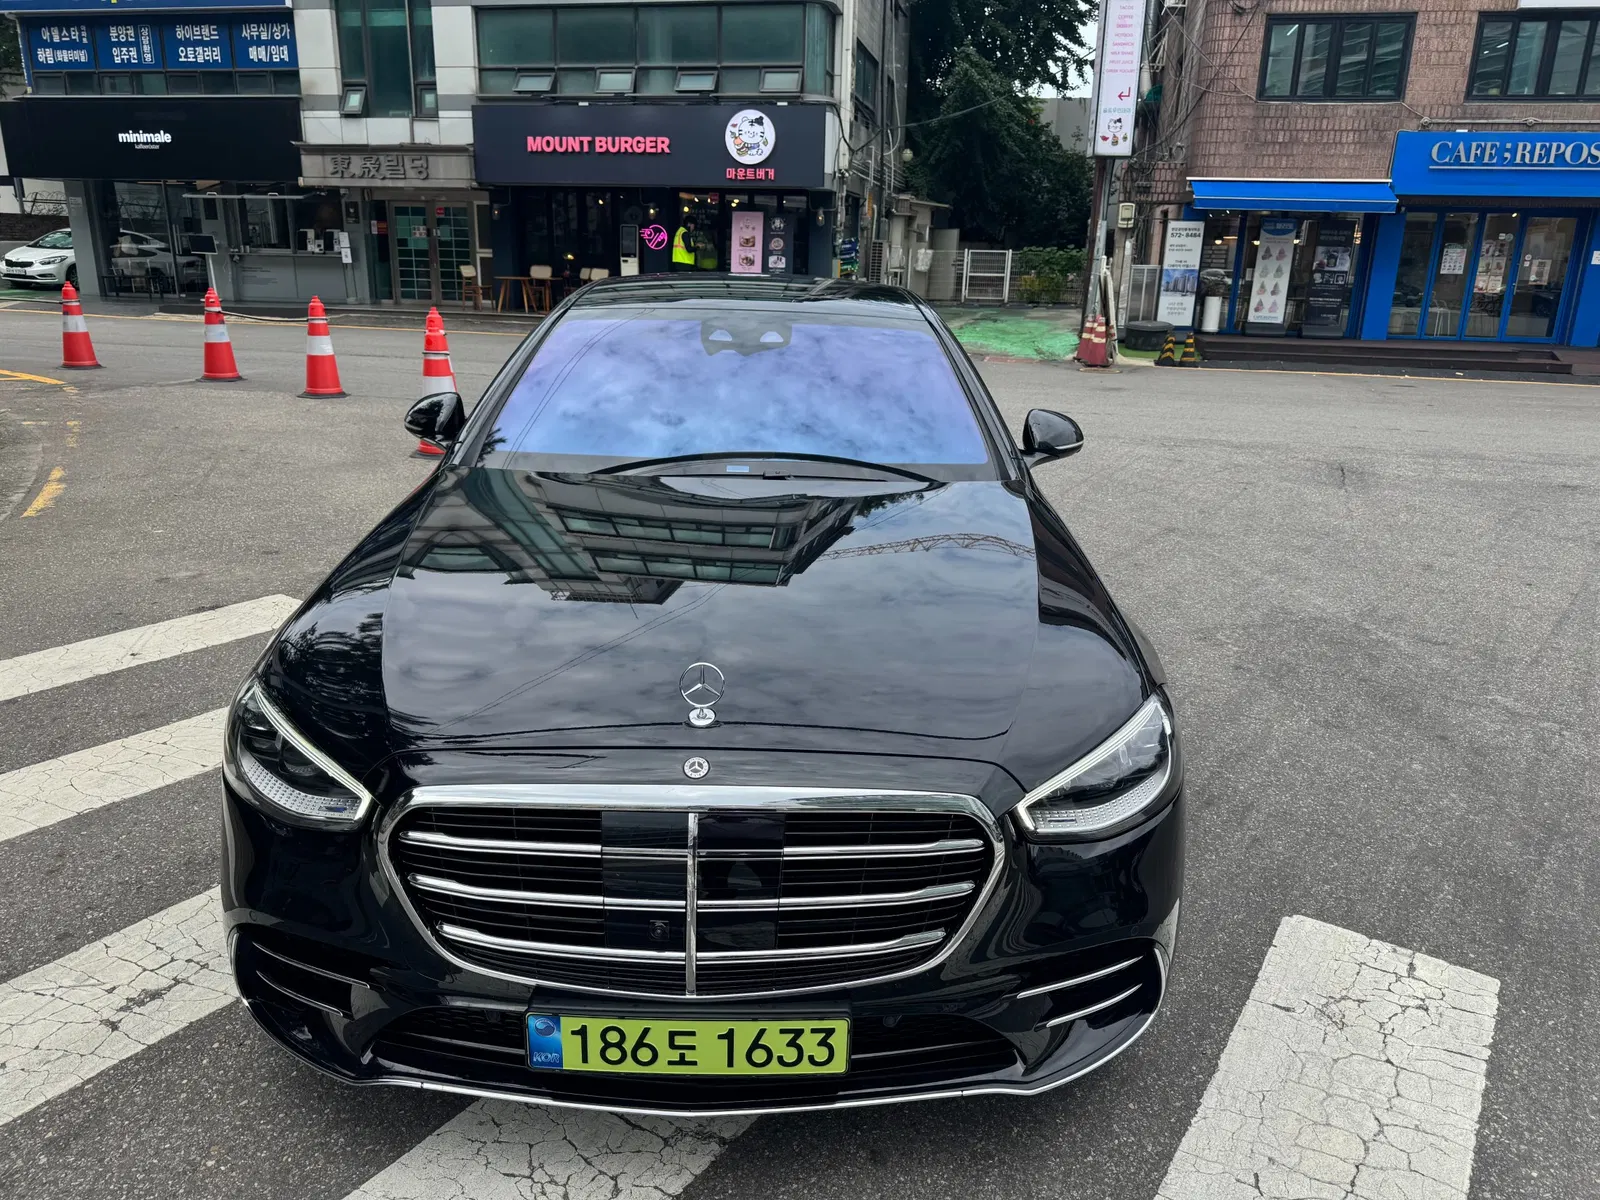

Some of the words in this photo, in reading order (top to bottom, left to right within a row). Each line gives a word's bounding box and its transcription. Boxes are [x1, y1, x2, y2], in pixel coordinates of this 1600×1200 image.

[41, 26, 79, 43] 아델스타
[109, 25, 135, 42] 분양권
[176, 24, 219, 41] 하이브랜드
[241, 23, 290, 40] 사무실/상가
[112, 47, 138, 63] 입주권
[178, 46, 222, 63] 오토갤러리
[248, 45, 289, 62] 매매/임대
[118, 130, 172, 143] minimale
[526, 136, 593, 154] MOUNT
[595, 136, 671, 154] BURGER
[725, 167, 775, 181] 마운트버거
[571, 1024, 698, 1068] 186도
[717, 1026, 836, 1068] 1633
[532, 1052, 561, 1064] KOR
